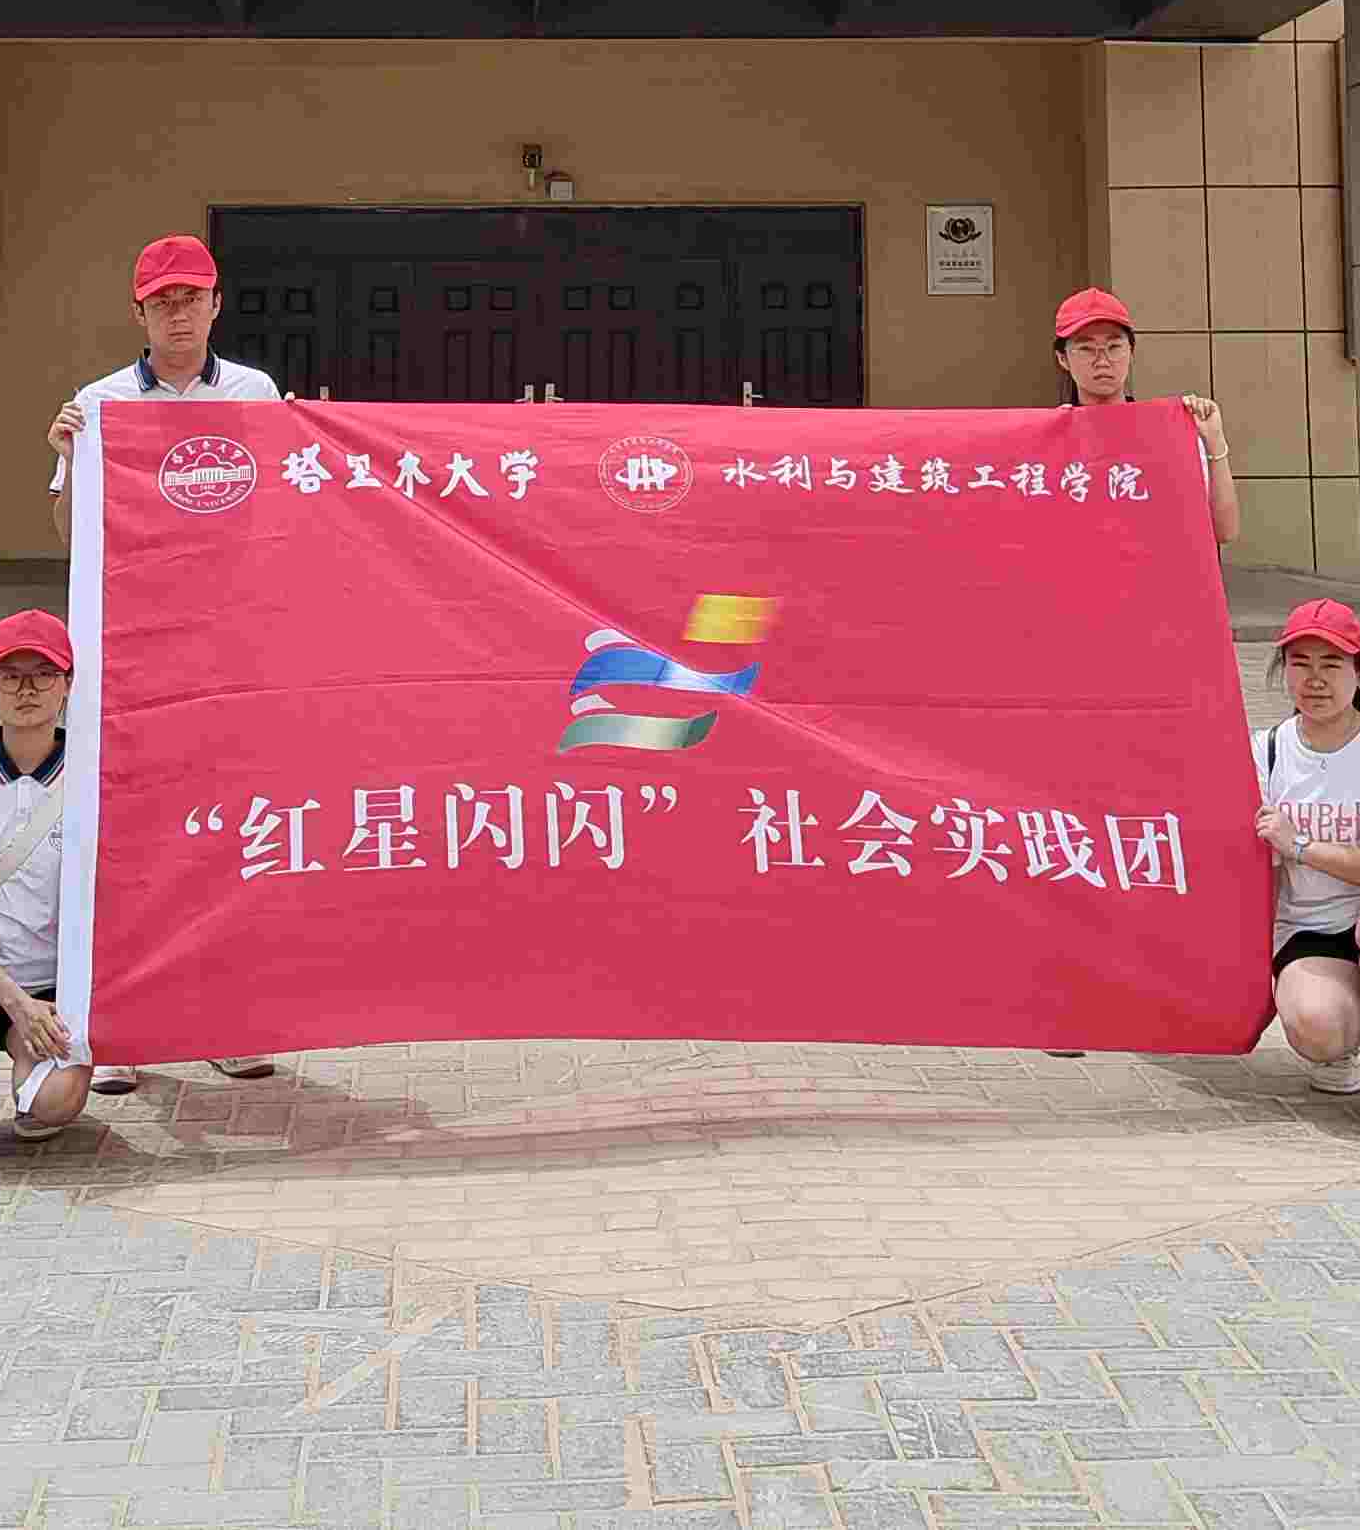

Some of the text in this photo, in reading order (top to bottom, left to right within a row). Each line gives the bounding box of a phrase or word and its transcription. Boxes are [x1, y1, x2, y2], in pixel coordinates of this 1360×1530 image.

[280, 442, 539, 501] 塔里木大学
[721, 454, 1151, 503] 水利与建筑工程学院
[737, 788, 1189, 896] 社会实践团
